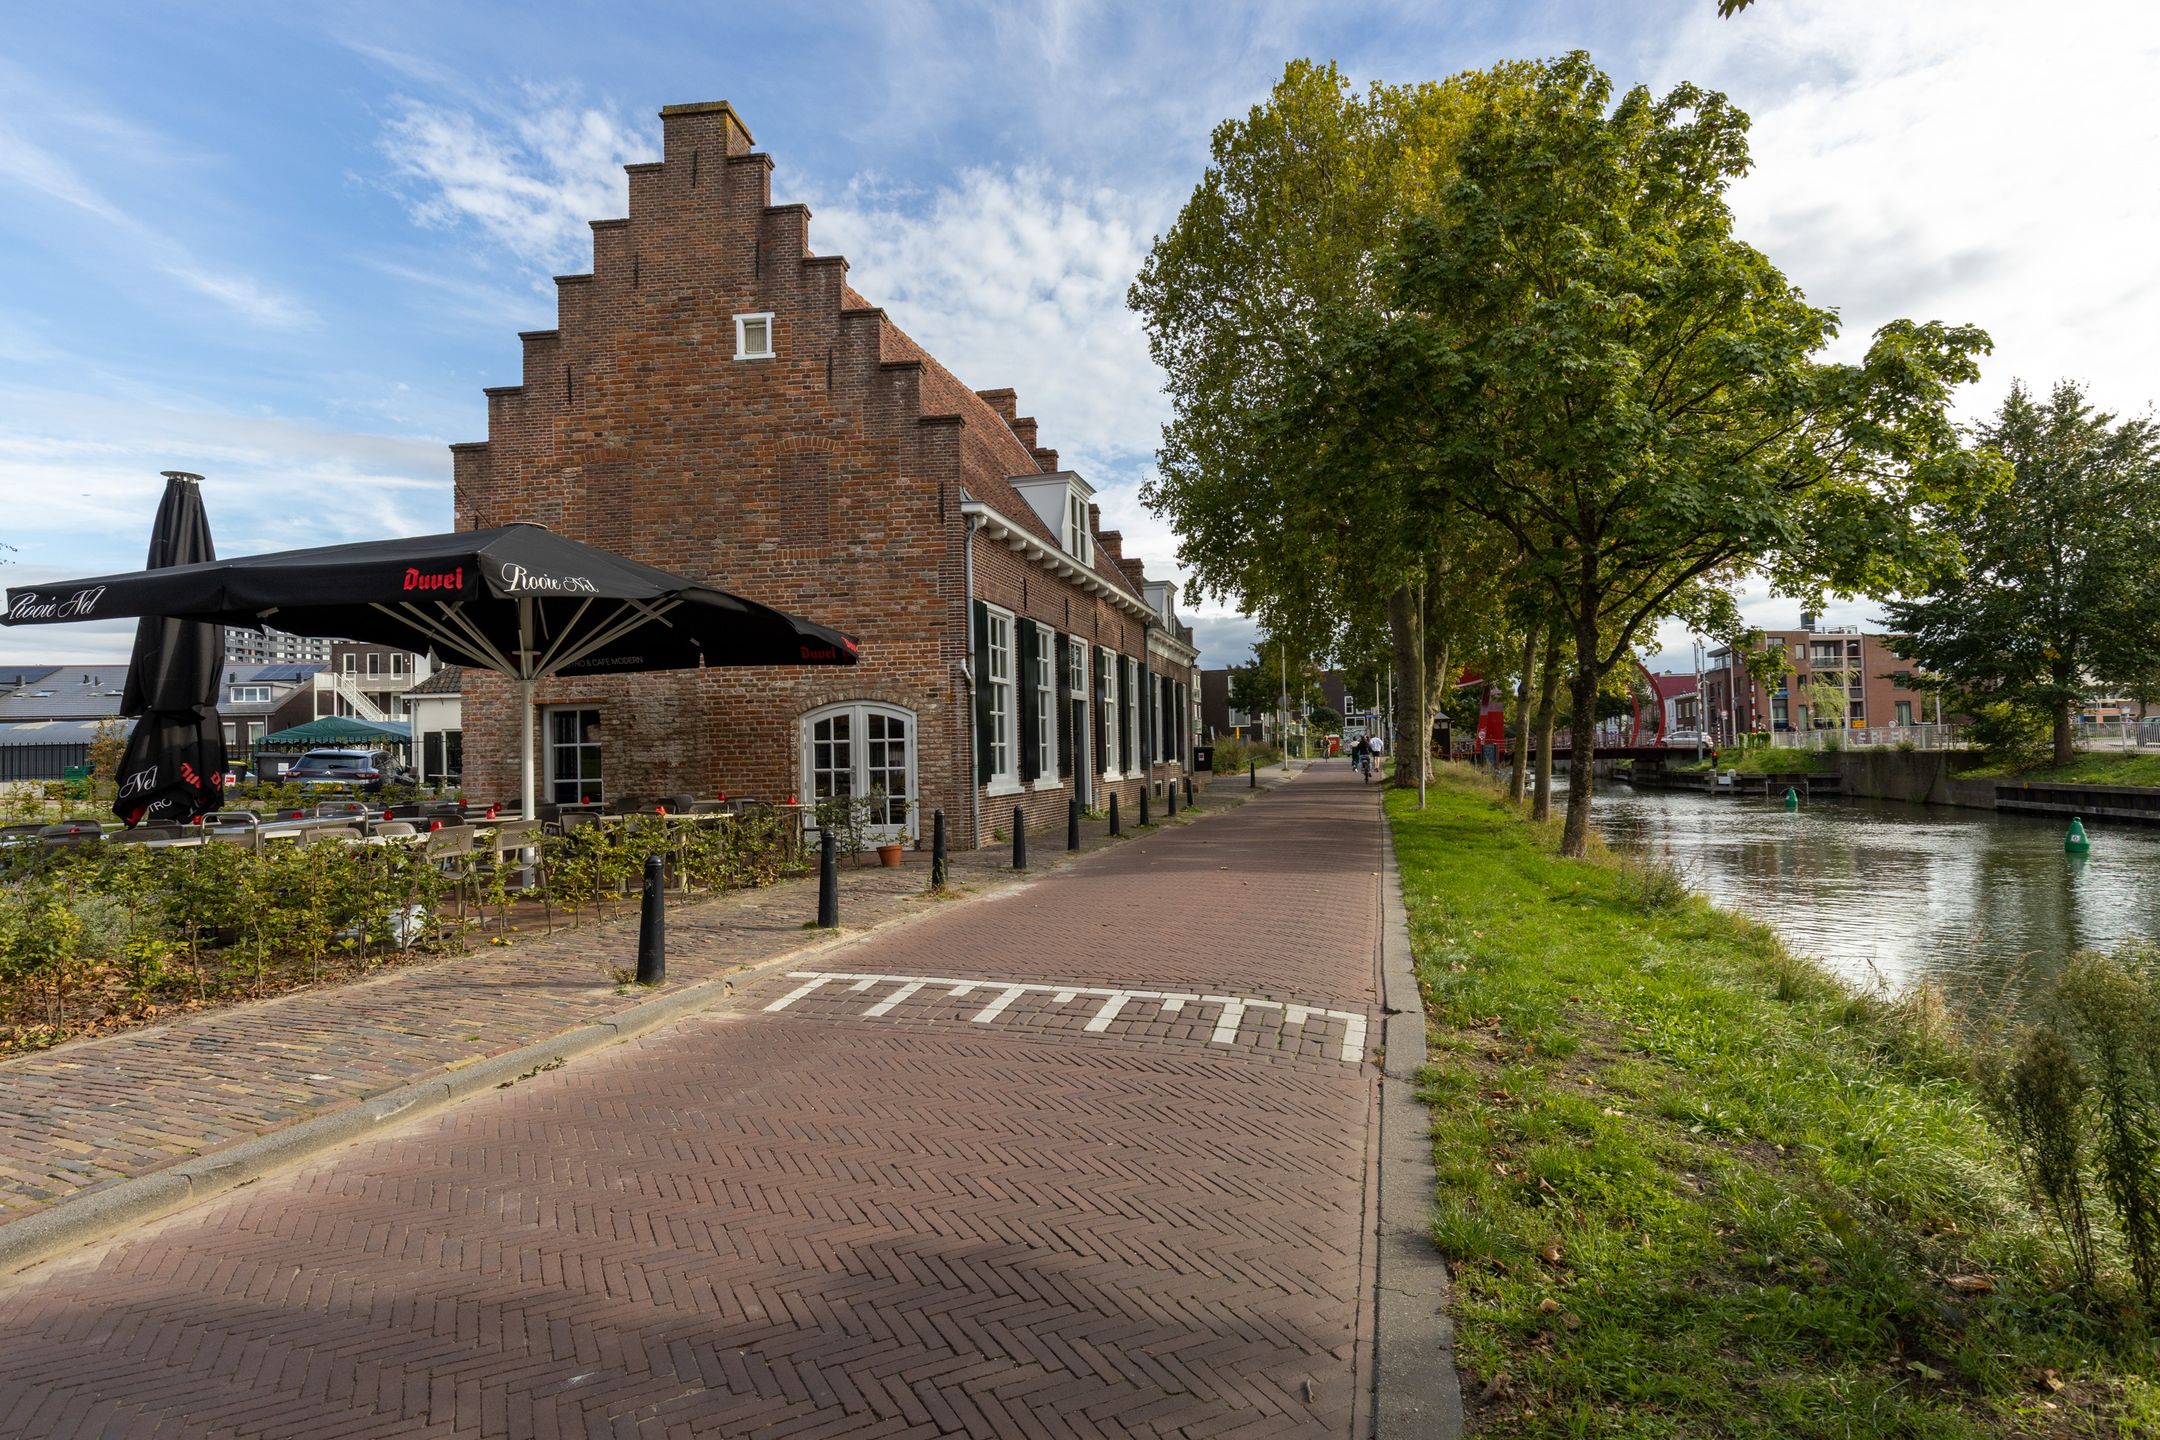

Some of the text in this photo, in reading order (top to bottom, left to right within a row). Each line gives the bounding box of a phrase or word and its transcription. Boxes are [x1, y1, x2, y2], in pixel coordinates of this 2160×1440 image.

[403, 566, 463, 591] Duvel
[502, 563, 600, 593] Rooie Nel
[9, 585, 107, 619] Rooie Nel
[611, 655, 644, 666] MODERN
[799, 645, 837, 661] Duvel
[119, 764, 159, 799] Nel
